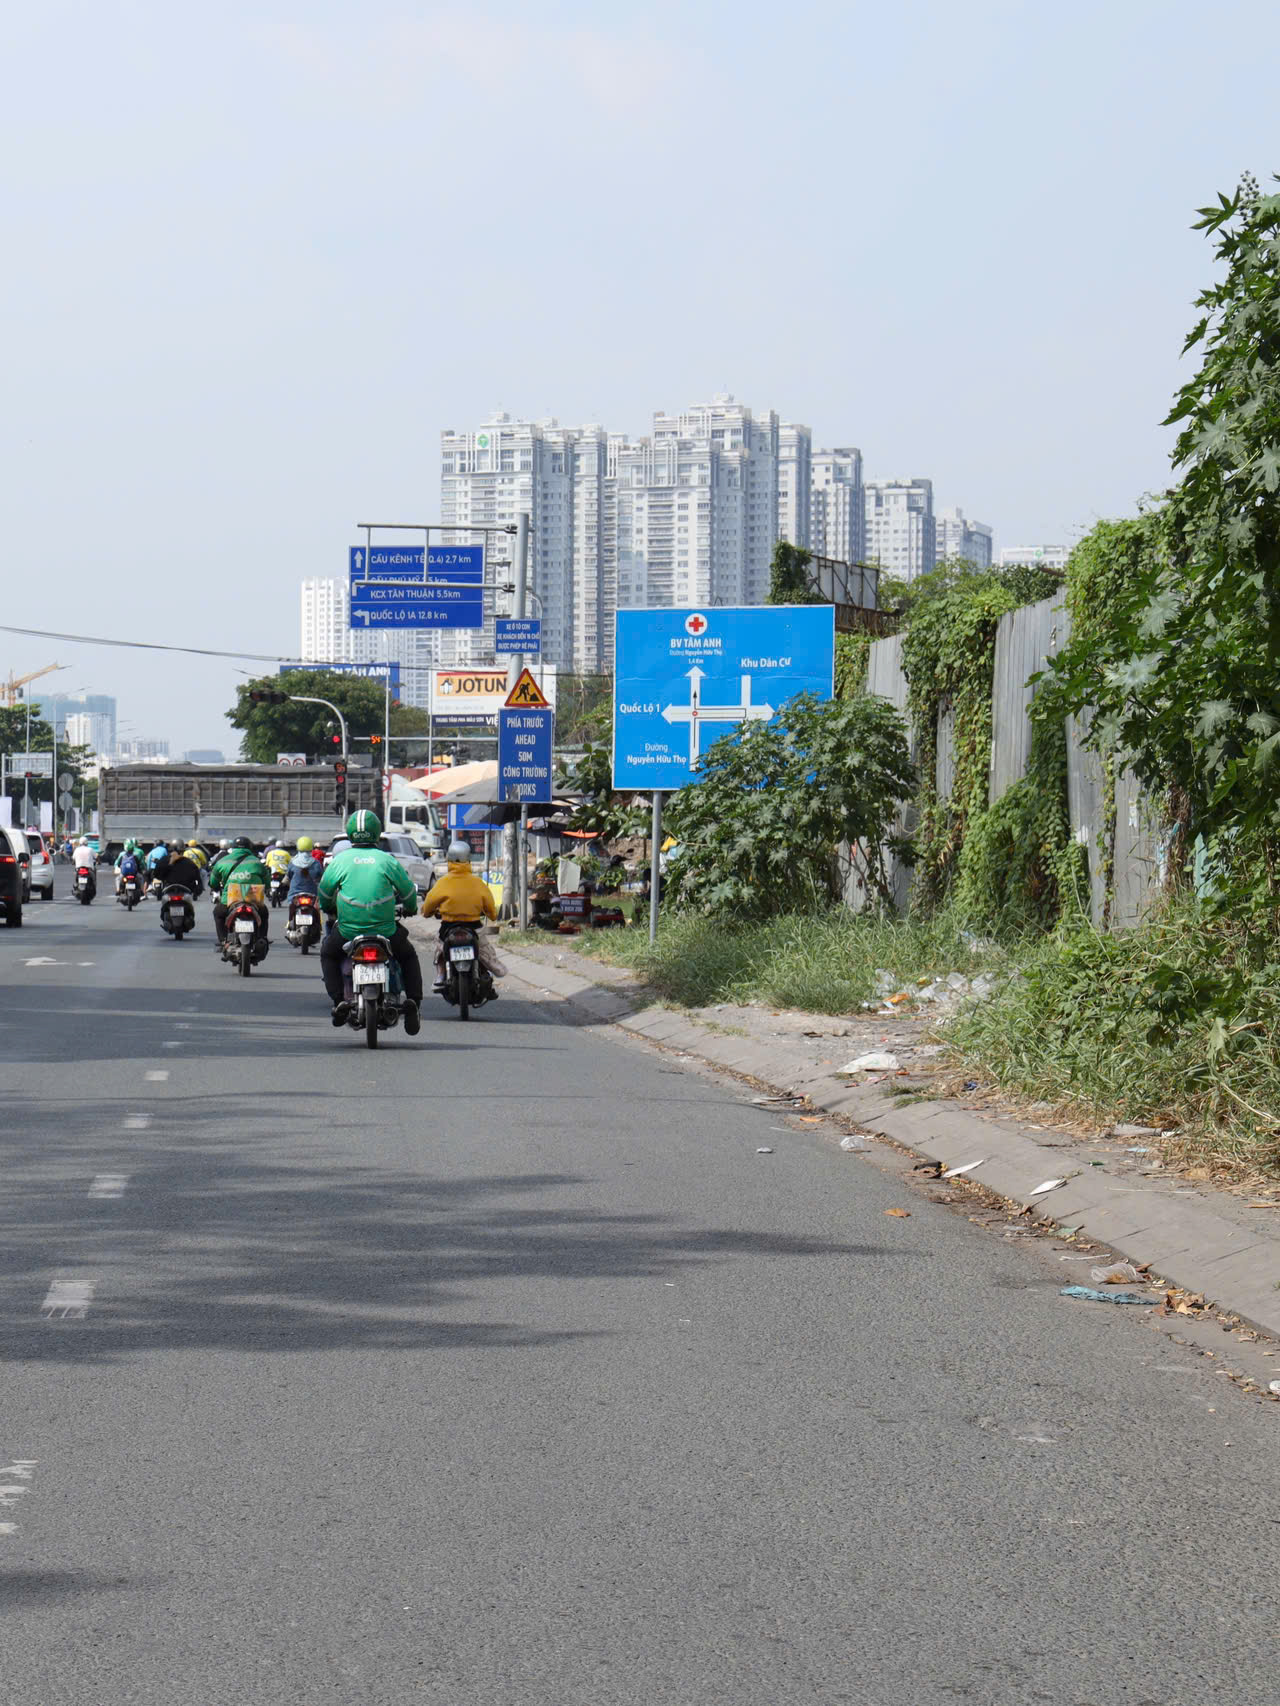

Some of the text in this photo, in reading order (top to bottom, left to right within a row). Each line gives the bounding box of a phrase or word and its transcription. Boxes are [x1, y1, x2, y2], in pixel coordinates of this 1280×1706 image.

[389, 552, 413, 564] KÊNH
[428, 554, 444, 565] Q.4)
[458, 555, 472, 564] km
[370, 589, 386, 599] KCX
[388, 588, 405, 599] TÂN
[406, 588, 435, 600] THUẬN
[370, 608, 393, 620] QUỐC
[394, 608, 406, 621] LỘ
[670, 636, 722, 648] BV TÂM ANH
[741, 658, 758, 668] Khu
[760, 657, 777, 668] Dân
[456, 677, 507, 694] JOTUN
[619, 702, 642, 714] Quốc
[643, 702, 654, 715] Lộ
[485, 715, 499, 728] VIỆ
[506, 715, 544, 728] PHÍA TRƯỚC
[515, 734, 536, 745] AHEAD
[644, 742, 669, 753] Đường
[518, 751, 533, 762] 50M
[627, 753, 687, 765] Nguyễn Hữu Thọ
[503, 765, 548, 778] CÔNG TRƯỜNG
[512, 783, 536, 796] ORKS
[352, 831, 371, 839] Grab
[230, 870, 251, 880] rab
